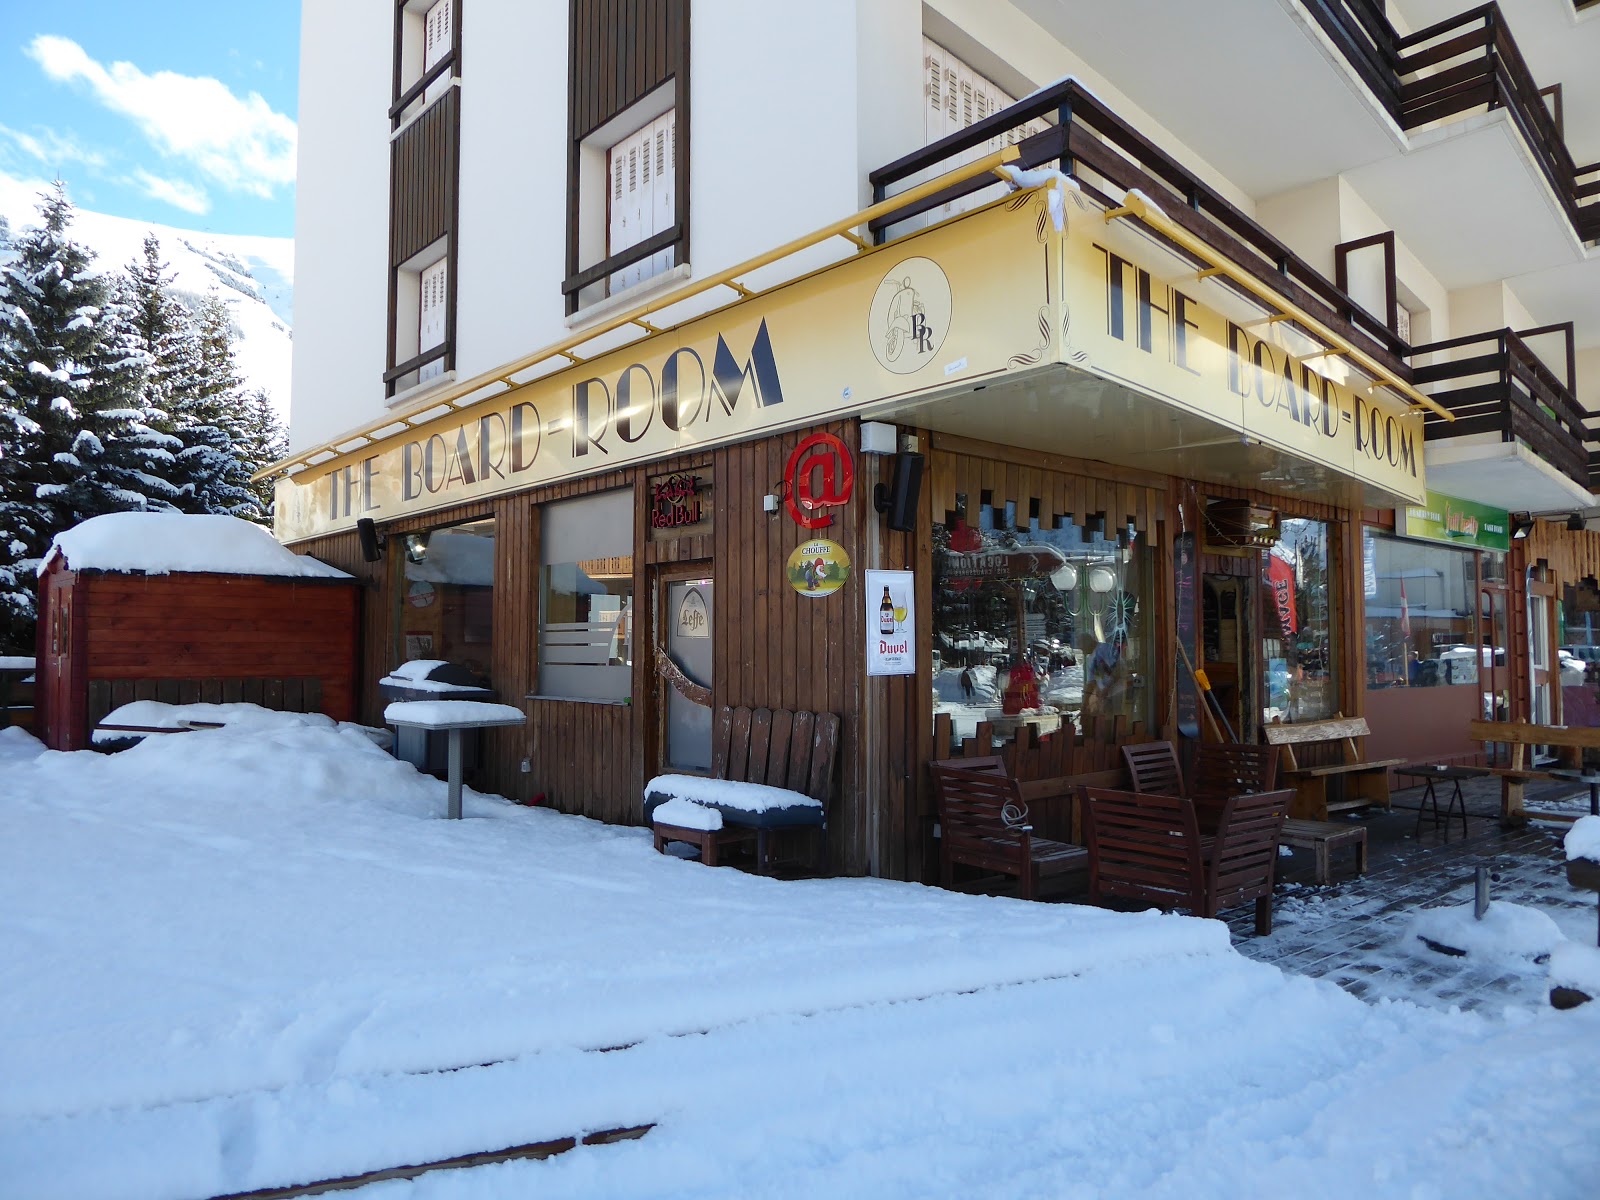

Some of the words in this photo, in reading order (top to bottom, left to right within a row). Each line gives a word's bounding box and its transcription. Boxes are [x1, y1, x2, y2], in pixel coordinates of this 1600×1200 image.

[1092, 242, 1201, 377] THE
[324, 454, 381, 521] THE
[651, 508, 676, 529] Red
[676, 500, 700, 525] Bull
[801, 546, 831, 555] CHOUFFE
[681, 609, 704, 632] Leffe
[879, 640, 908, 654] Duvel
